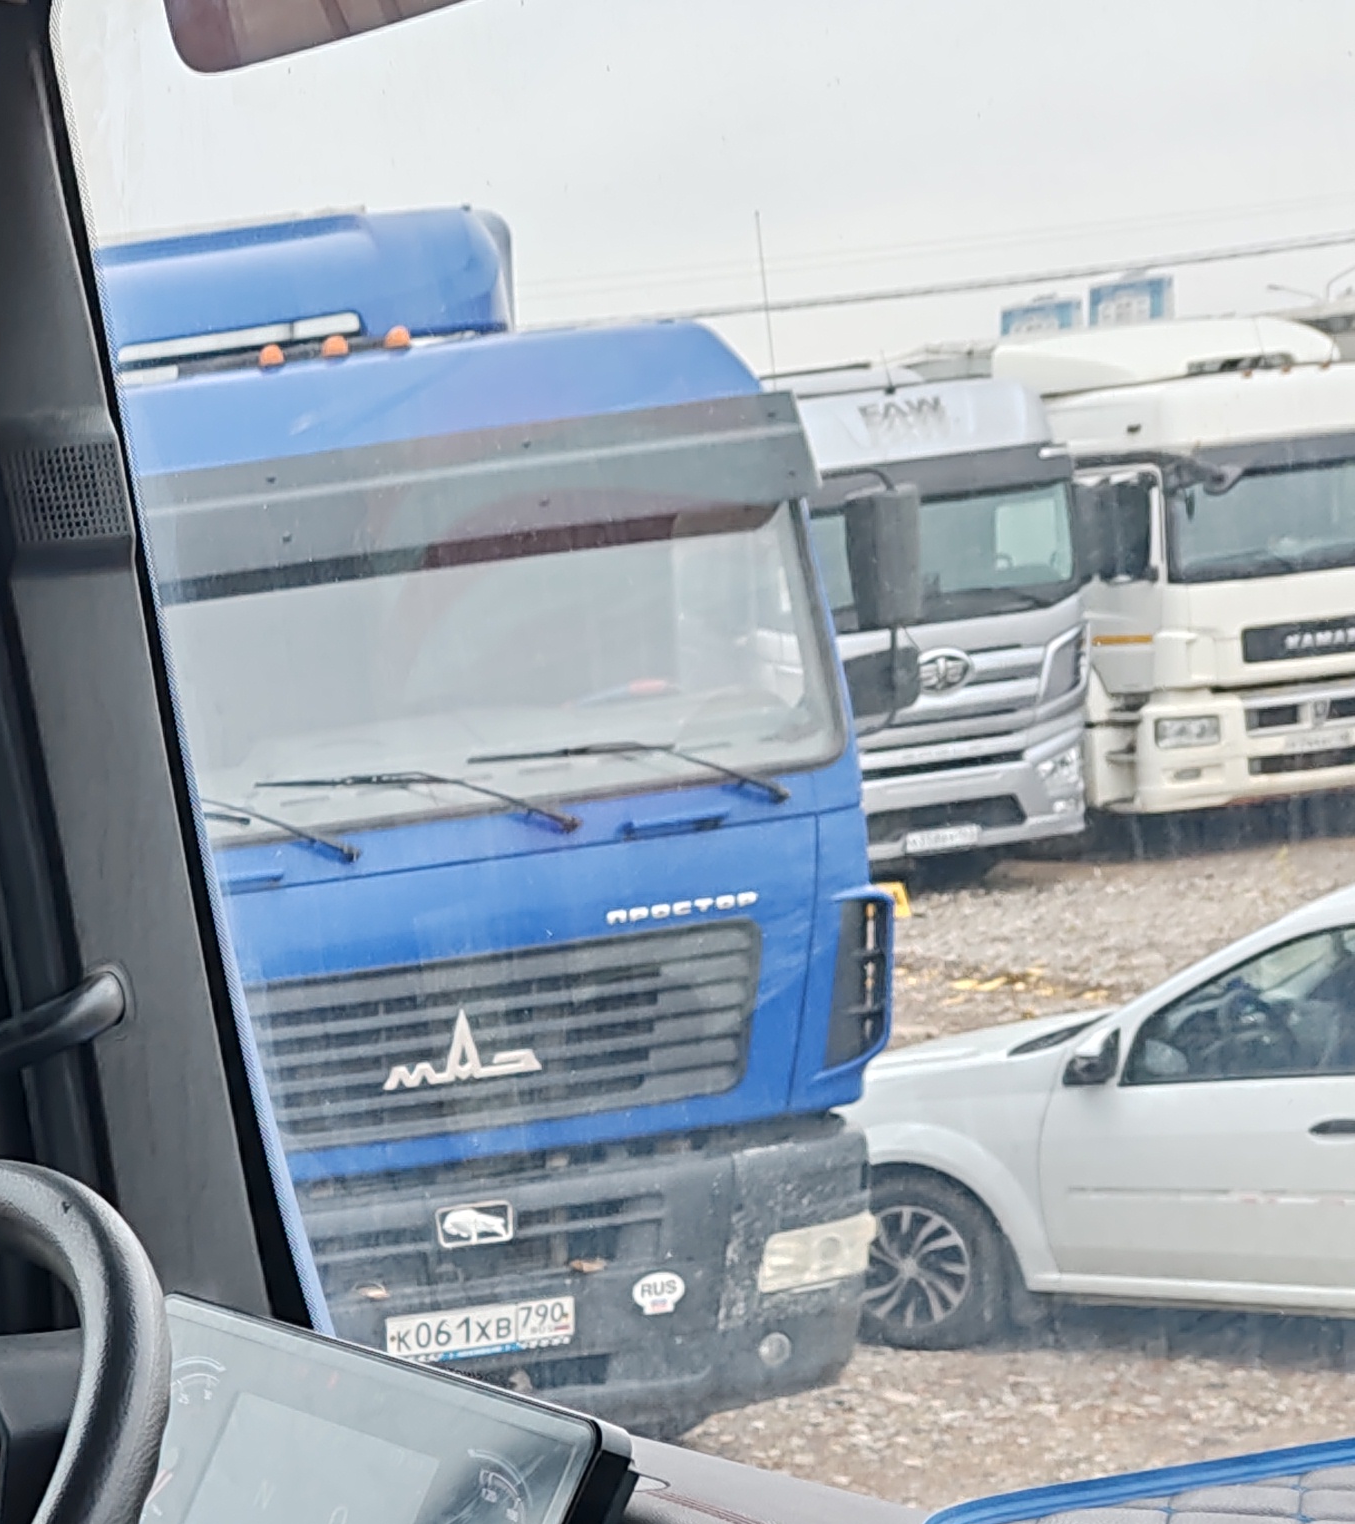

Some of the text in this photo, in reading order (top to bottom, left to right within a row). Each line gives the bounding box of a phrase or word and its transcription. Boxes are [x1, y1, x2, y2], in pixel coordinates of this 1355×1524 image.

[606, 891, 758, 925] ПРОСТОР
[640, 1279, 678, 1298] RUS
[520, 1301, 565, 1329] 790
